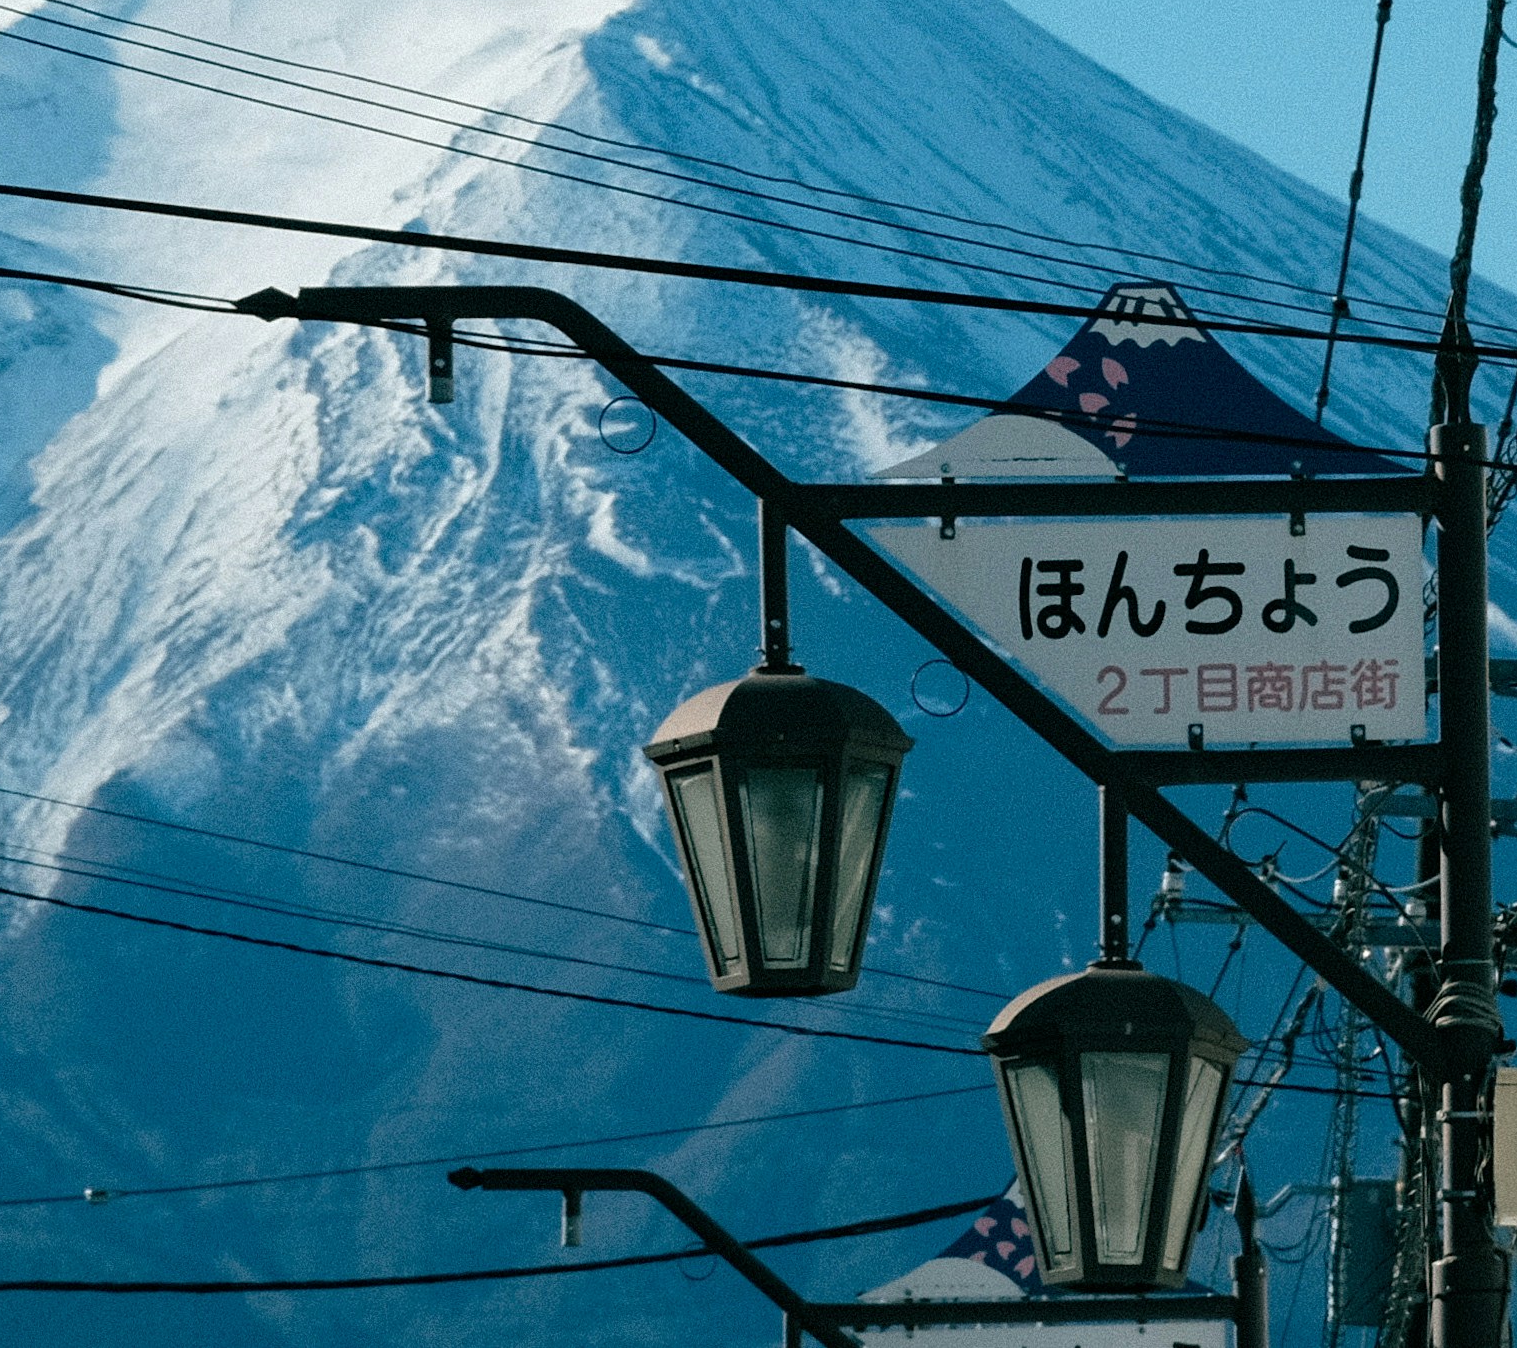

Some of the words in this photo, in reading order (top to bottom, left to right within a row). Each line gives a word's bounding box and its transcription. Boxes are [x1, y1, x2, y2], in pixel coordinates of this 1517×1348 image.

[1019, 546, 1400, 641] ほんちょう
[1096, 659, 1400, 715] 2丁目商店街
